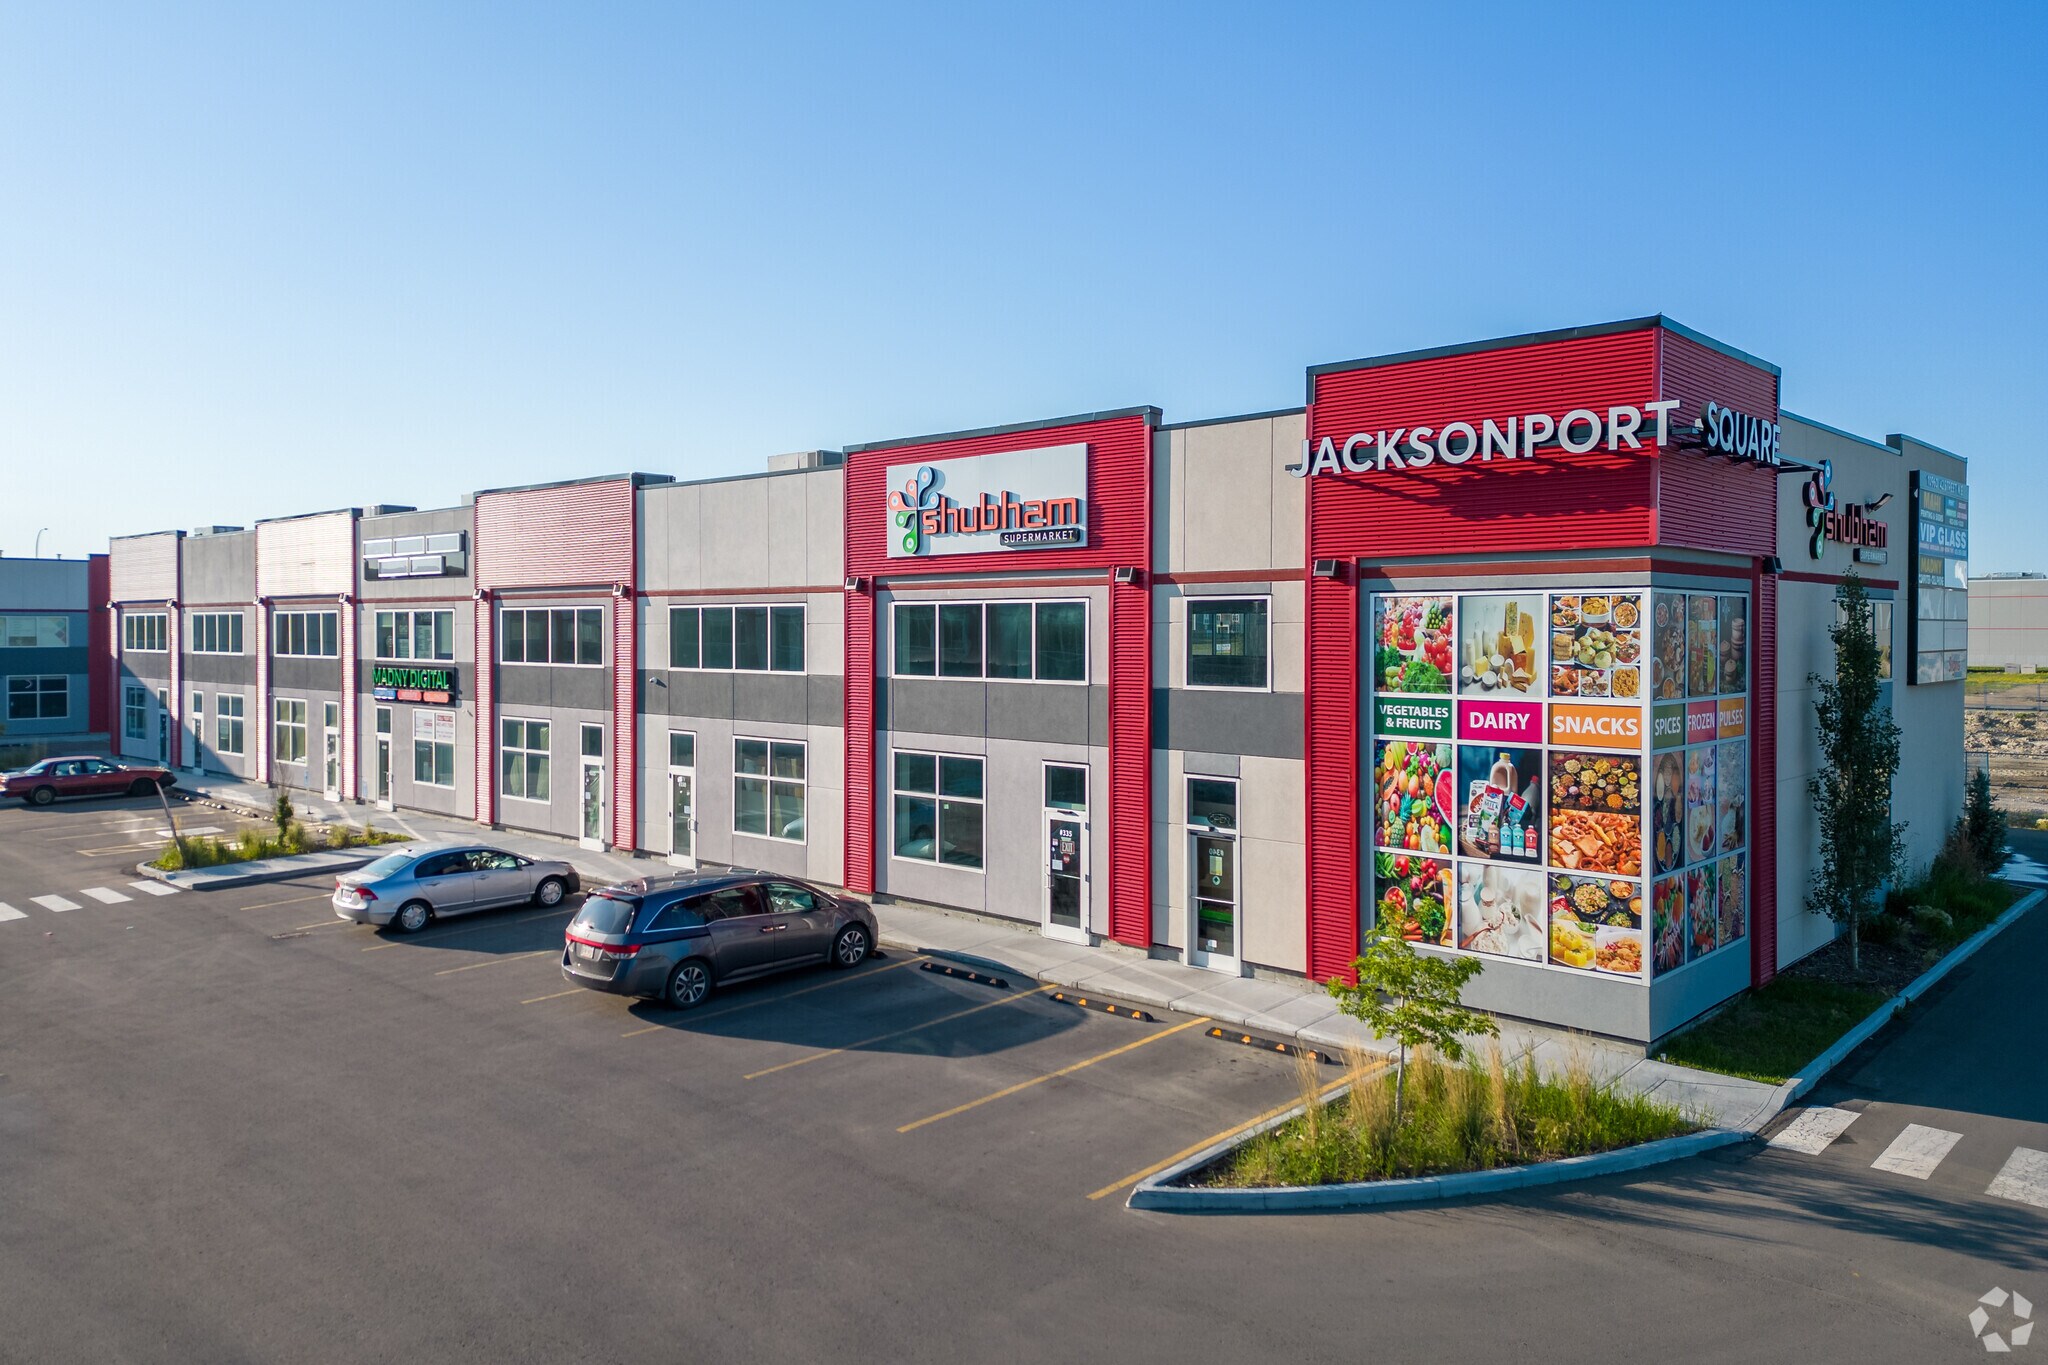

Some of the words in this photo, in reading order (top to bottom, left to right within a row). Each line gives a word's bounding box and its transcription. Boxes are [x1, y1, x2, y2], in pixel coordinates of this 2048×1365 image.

[1289, 400, 1681, 479] JACKSONPORT
[1707, 401, 1781, 466] SQUARE
[922, 490, 1078, 535] shubham
[1826, 500, 1888, 548] shubham
[1004, 530, 1074, 544] SUPERMARKET
[1920, 522, 1936, 543] VIP
[1937, 526, 1967, 549] GLASS
[373, 667, 408, 688] MADNY
[409, 668, 449, 689] DIGITAL
[1379, 704, 1449, 718] VEGETABLES
[1469, 711, 1530, 731] DAIRY
[1687, 711, 1715, 731] FROZEN
[1719, 708, 1743, 728] PULSES
[1385, 717, 1395, 728] &
[1396, 717, 1442, 731] FREUITS
[1552, 715, 1639, 736] SNACKS
[1654, 715, 1681, 736] SPICES
